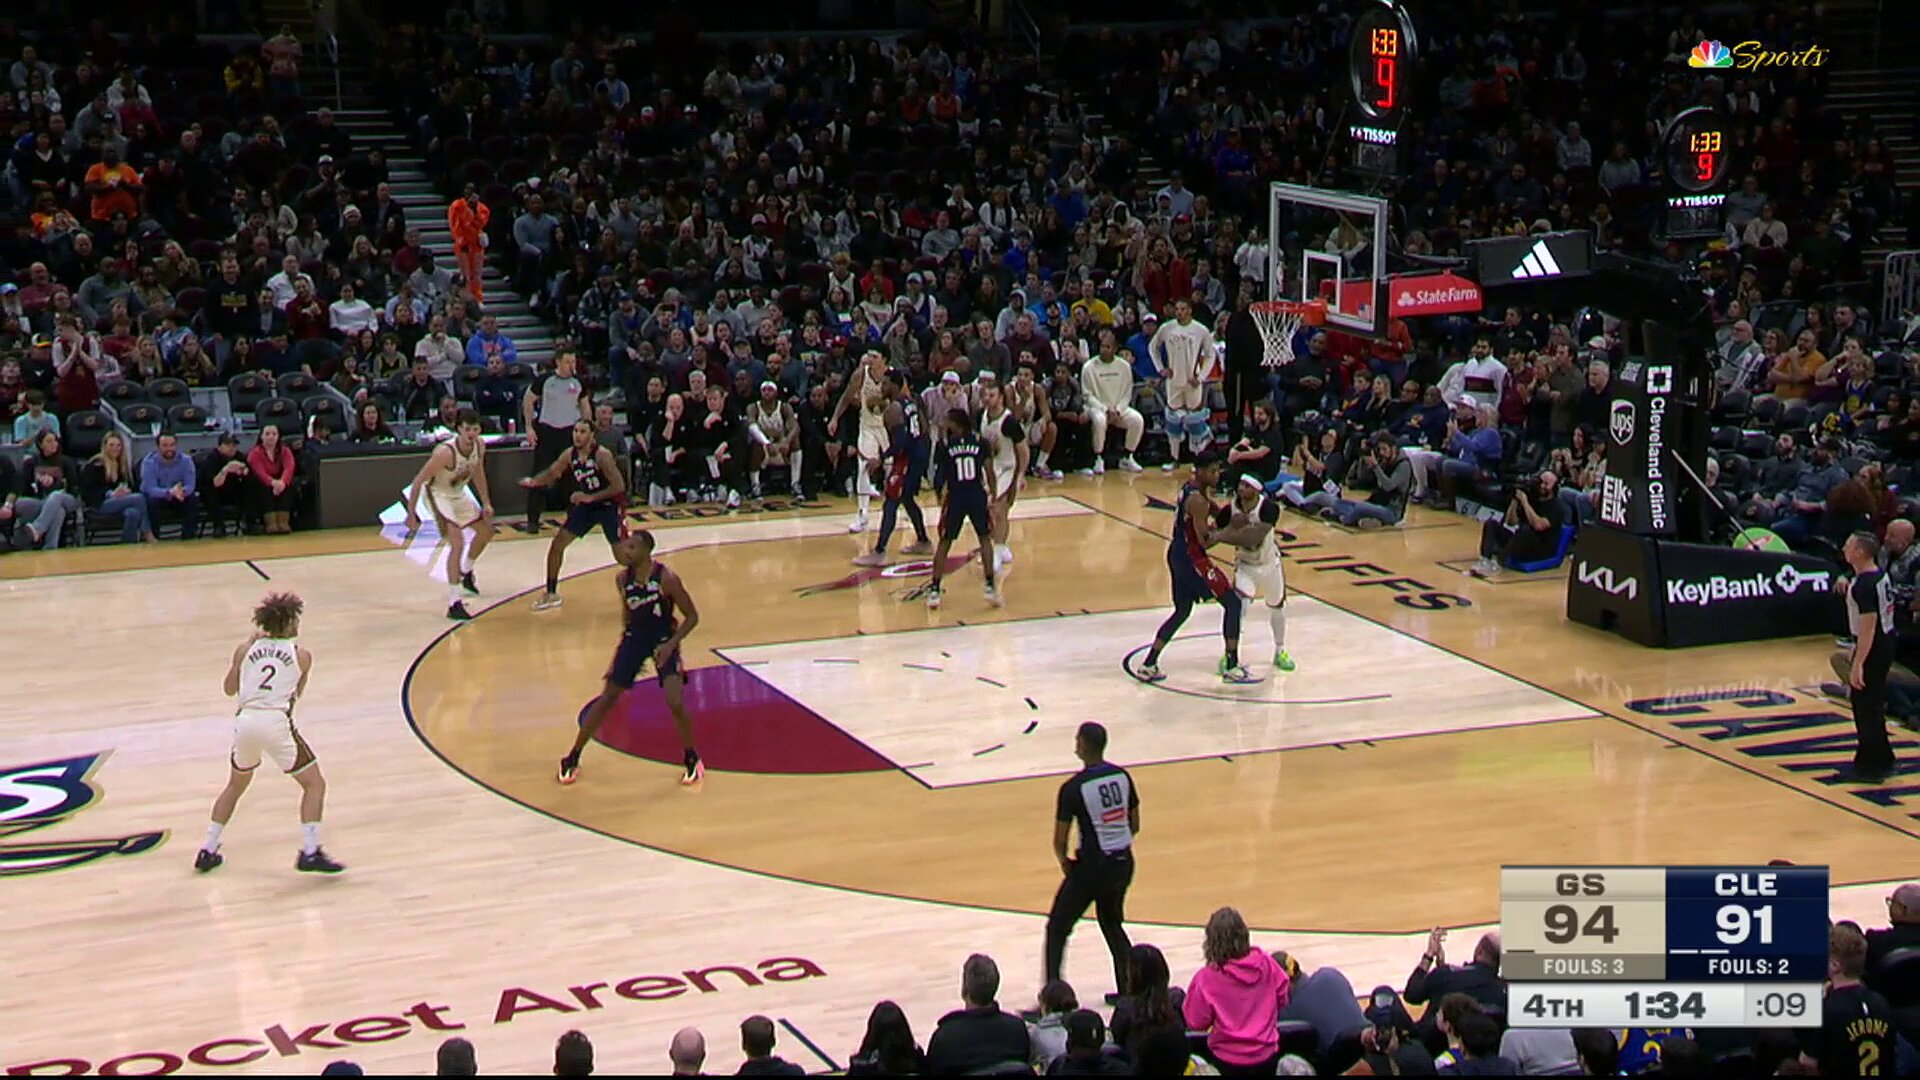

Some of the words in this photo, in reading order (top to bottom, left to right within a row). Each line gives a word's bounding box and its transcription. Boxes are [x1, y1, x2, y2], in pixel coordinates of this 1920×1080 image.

[1372, 28, 1397, 56] 1:33
[1376, 57, 1394, 108] 9
[1363, 127, 1397, 145] TISSOT
[1690, 131, 1721, 152] 1:33
[1697, 153, 1713, 180] 9
[1683, 195, 1725, 207] TISSOT
[1648, 397, 1666, 479] Cleveland
[955, 456, 976, 481] 10
[1601, 499, 1627, 526] Elk
[1649, 481, 1667, 529] Clinic
[1667, 573, 1774, 606] KeyBank
[258, 664, 277, 690] 2
[1098, 781, 1122, 809] 80
[494, 956, 828, 1024] Arena
[1845, 1017, 1889, 1041] JEROME
[1858, 1040, 1880, 1076] 2
